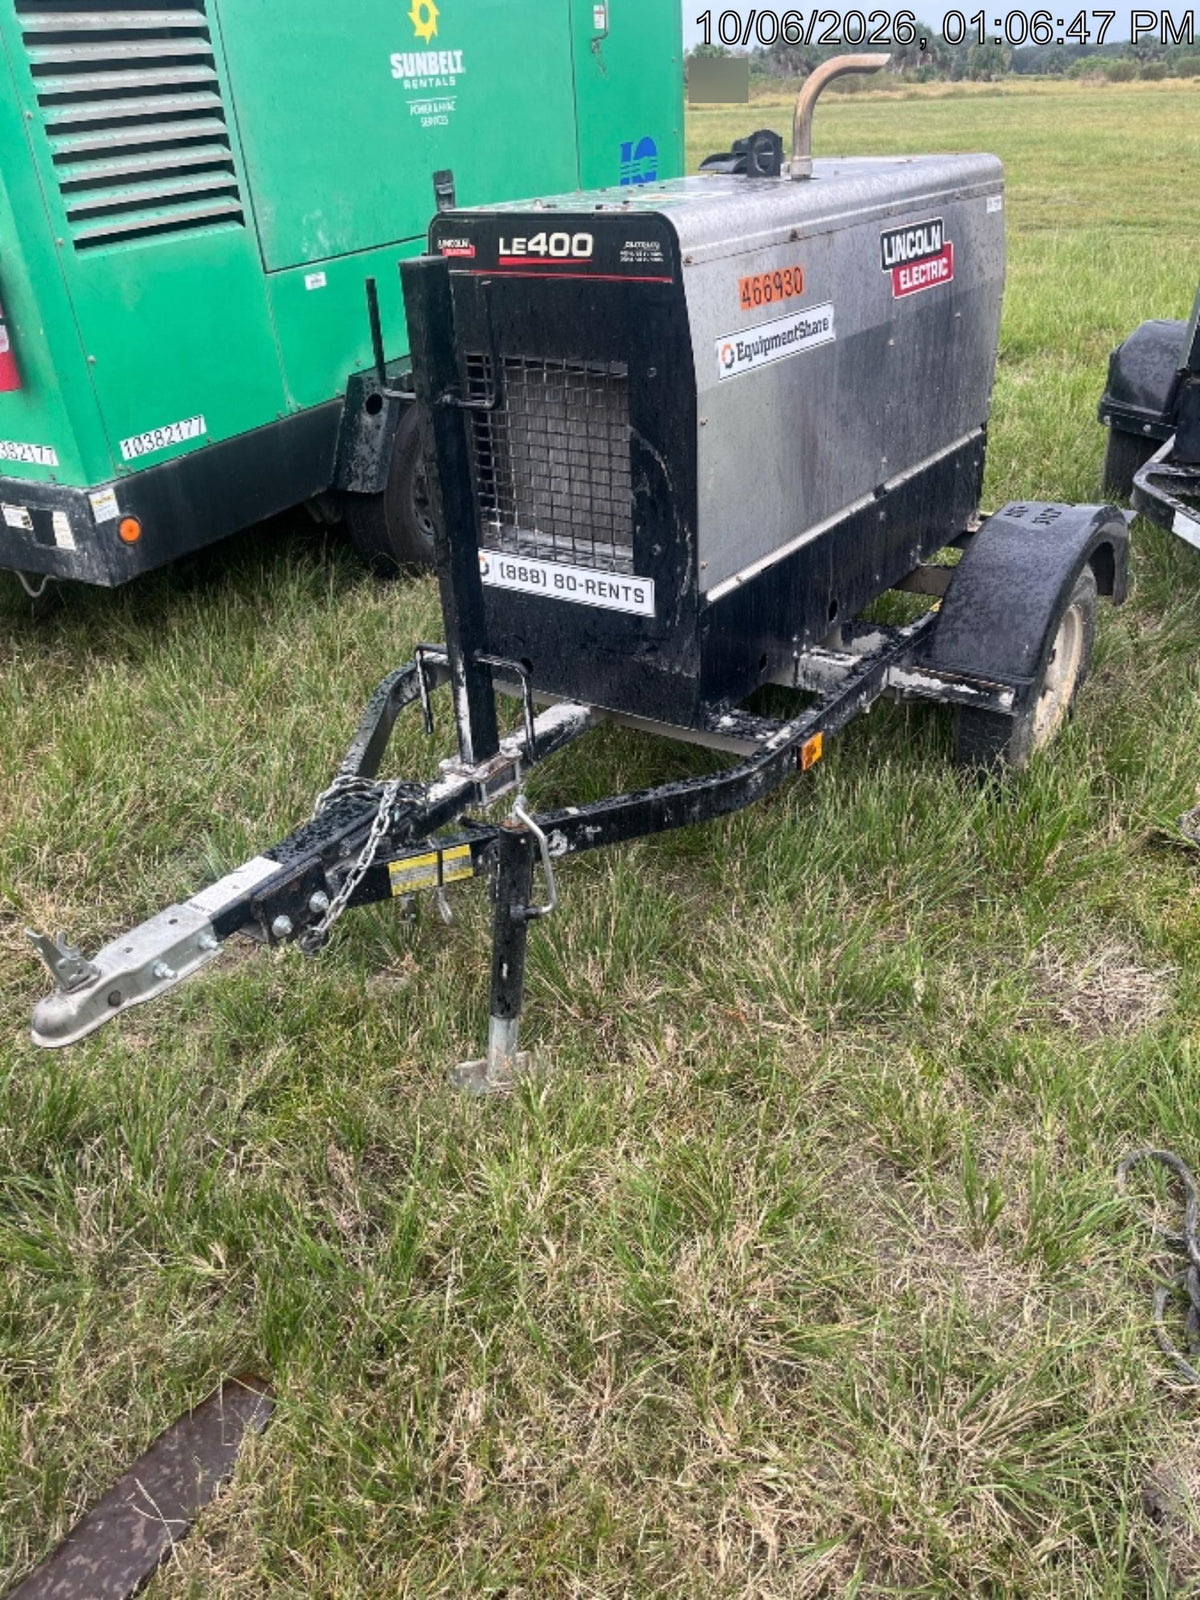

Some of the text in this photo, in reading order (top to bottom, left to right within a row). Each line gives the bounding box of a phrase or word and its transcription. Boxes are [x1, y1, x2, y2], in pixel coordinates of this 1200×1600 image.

[390, 50, 463, 79] SUNBELT
[403, 76, 456, 90] RENTALS
[498, 232, 593, 258] LE400
[882, 223, 942, 266] LINCOLN
[740, 266, 804, 308] 466930
[900, 256, 948, 290] ELECTRIC
[735, 317, 829, 364] EquipmentShare
[123, 415, 204, 458] 10382177
[499, 561, 645, 604] (888) 80-RENTS
